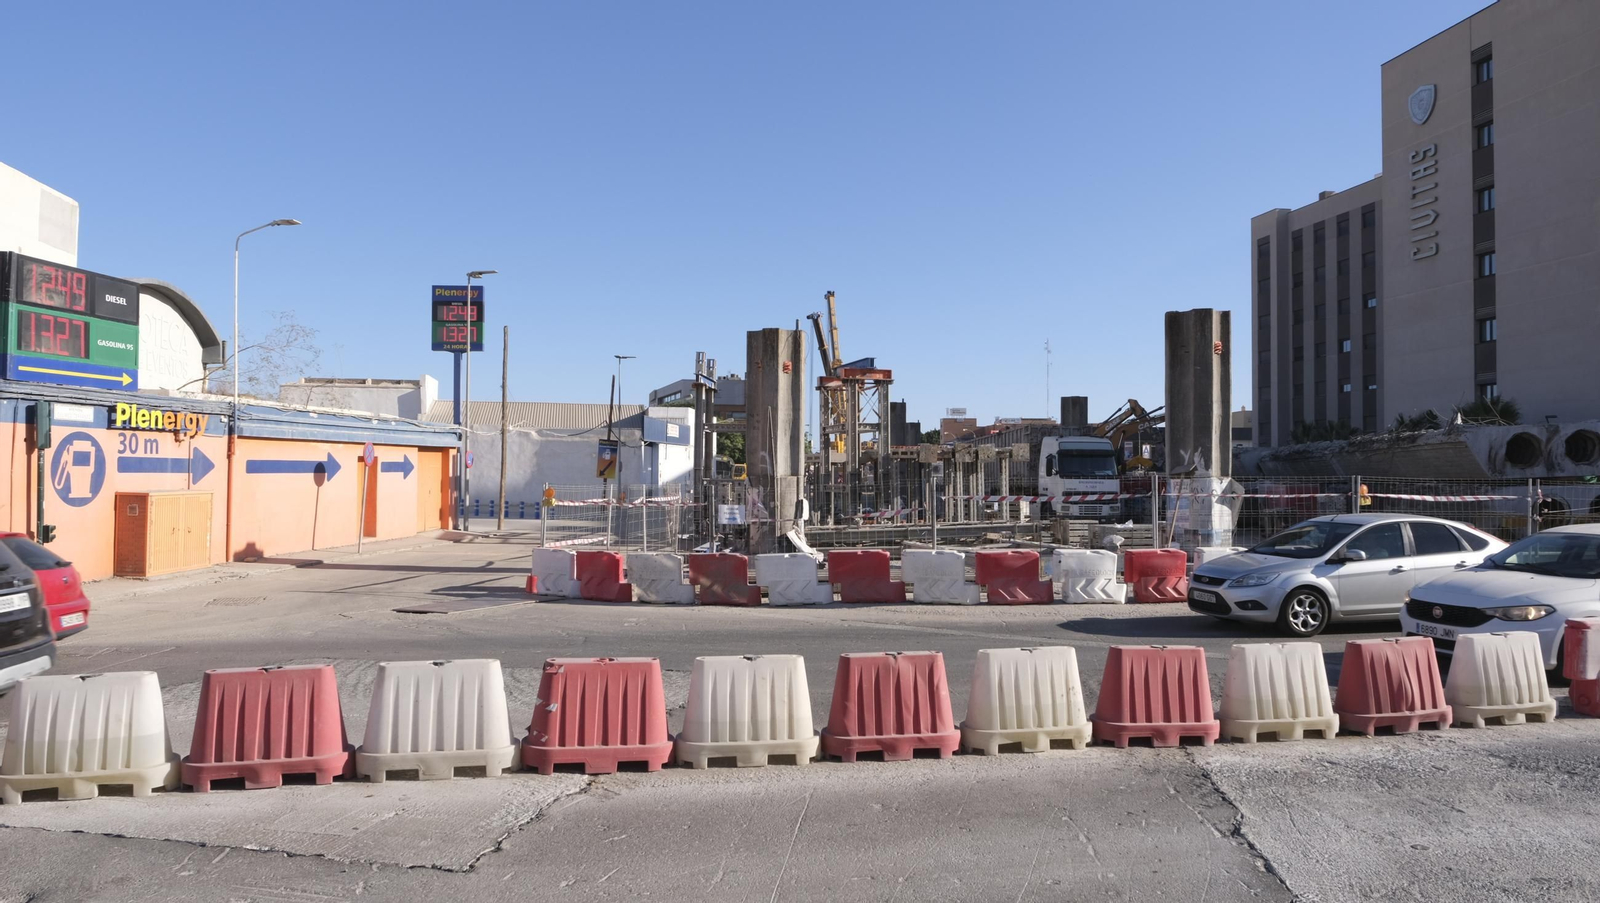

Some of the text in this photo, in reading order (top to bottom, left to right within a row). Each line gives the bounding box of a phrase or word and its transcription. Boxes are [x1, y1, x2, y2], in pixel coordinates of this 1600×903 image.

[105, 294, 128, 306] DIESEL
[97, 339, 134, 351] GASOLINA 95
[116, 402, 210, 436] Plenergy
[117, 432, 159, 455] 30 m
[1420, 624, 1455, 639] 6890 JMN
